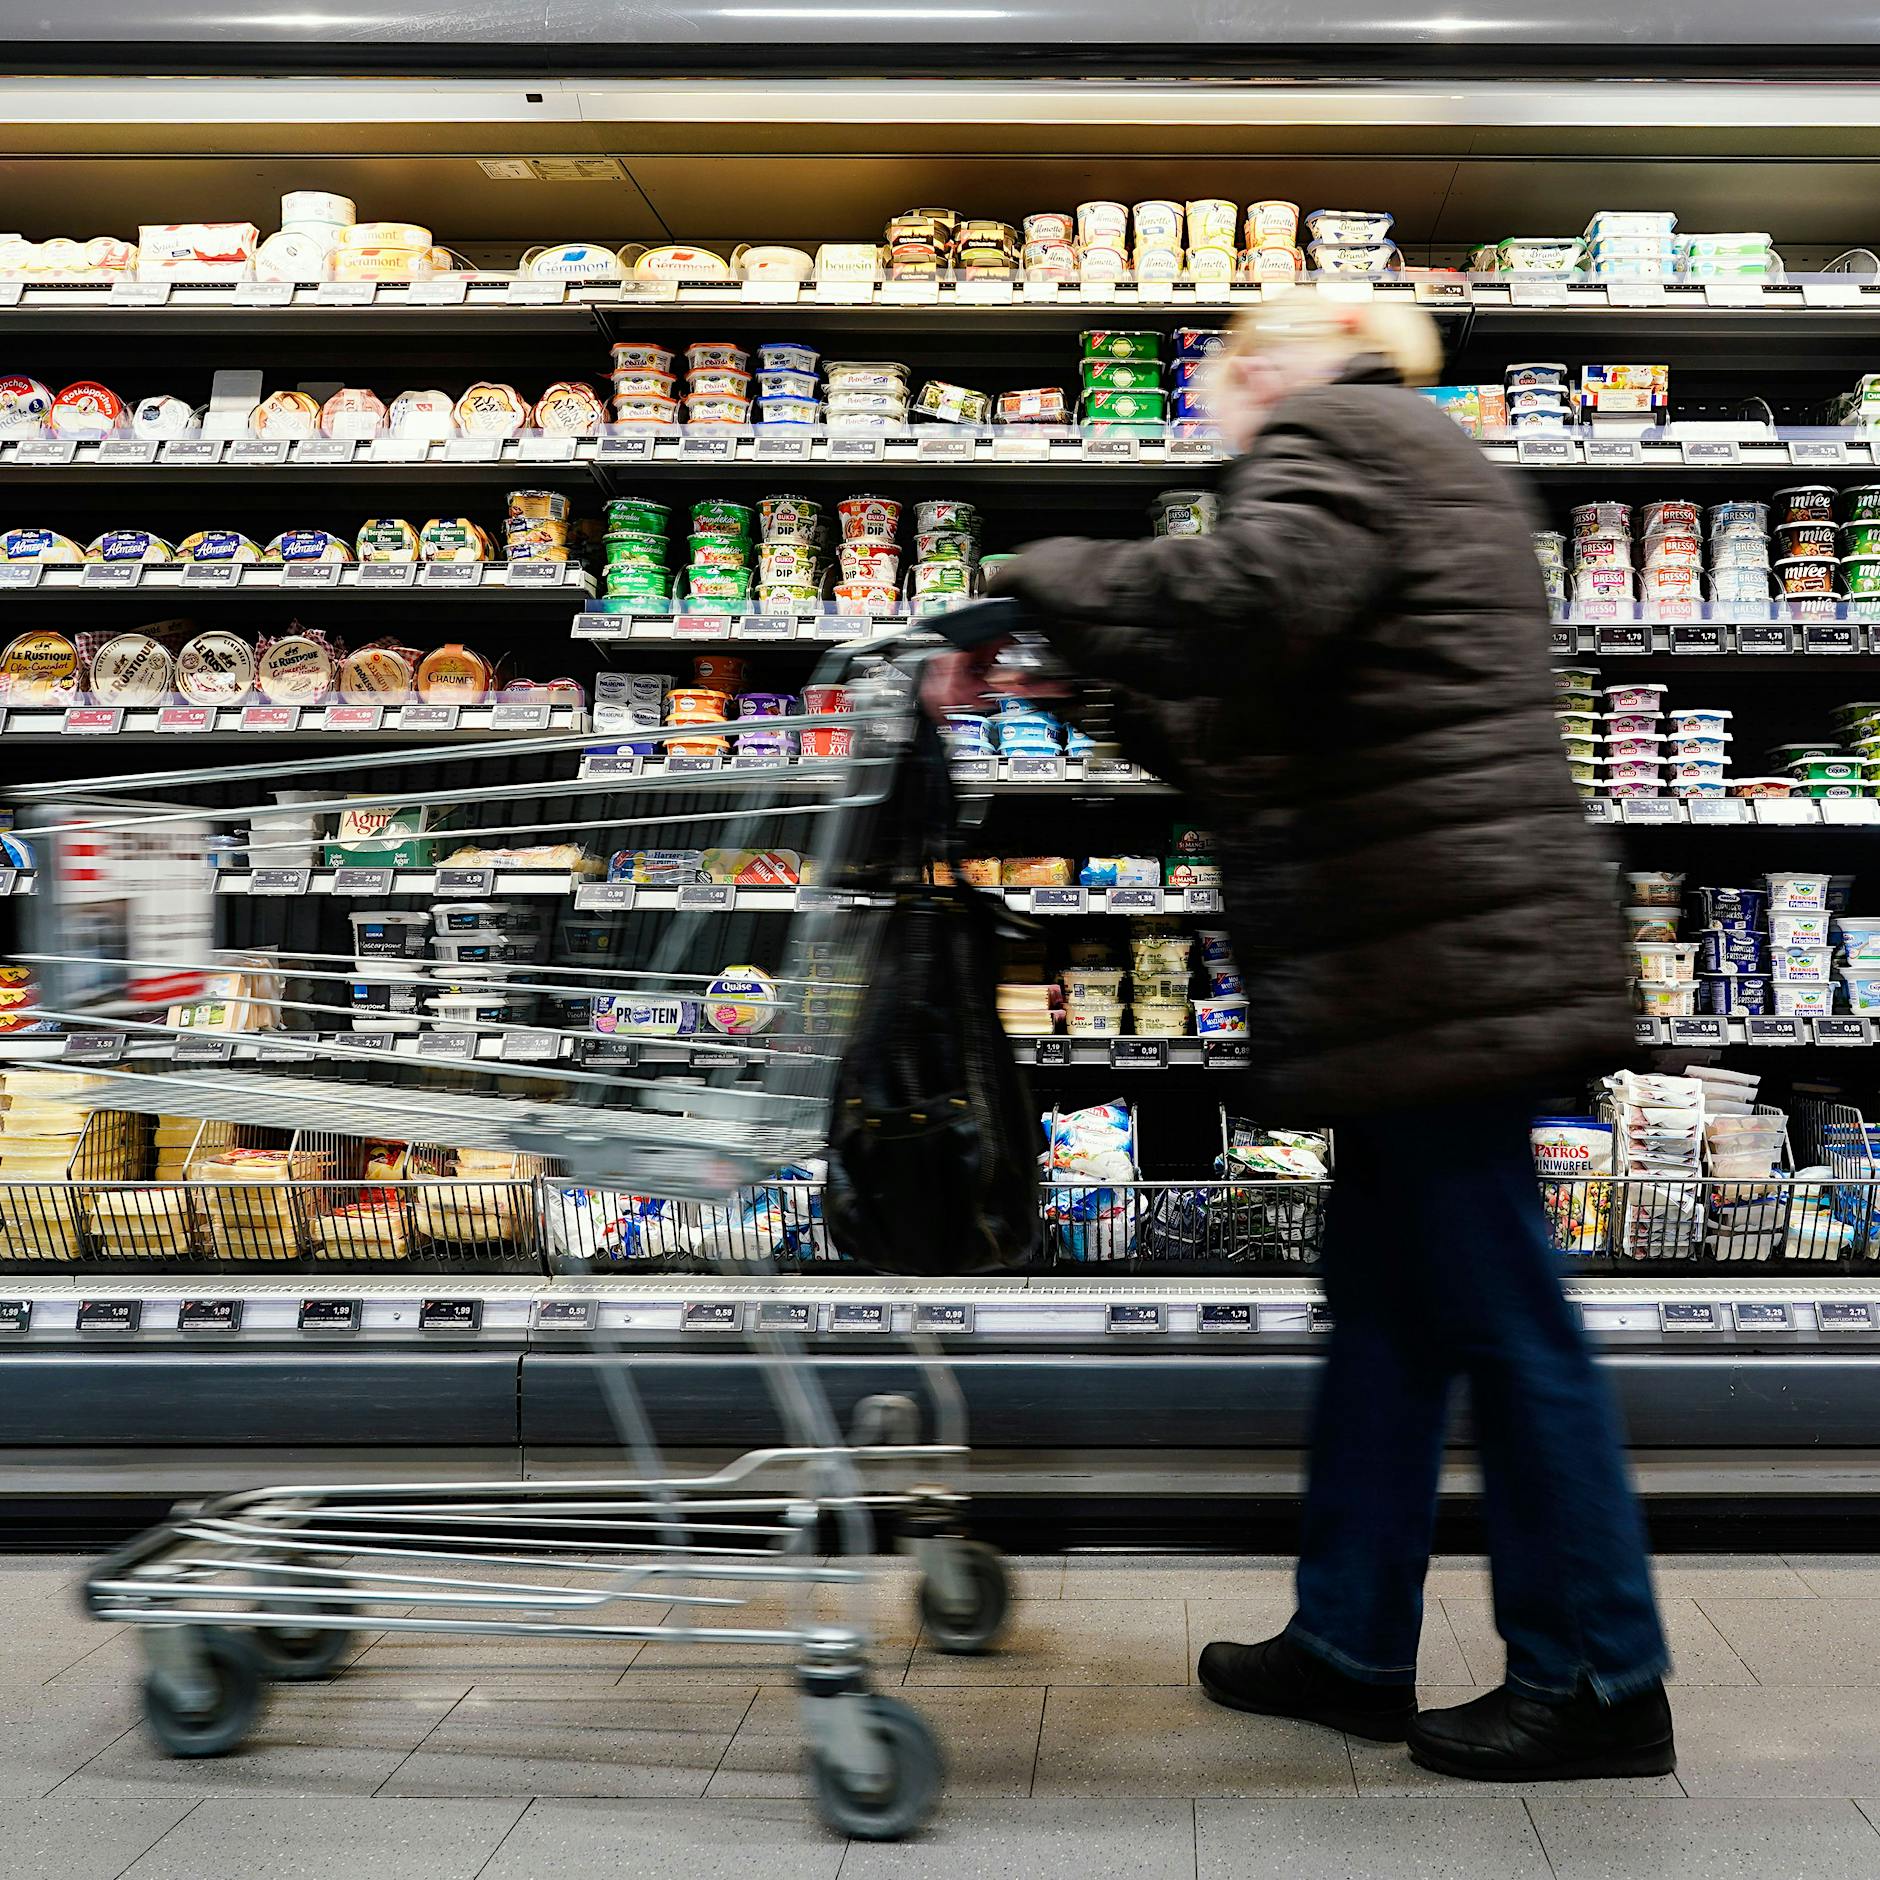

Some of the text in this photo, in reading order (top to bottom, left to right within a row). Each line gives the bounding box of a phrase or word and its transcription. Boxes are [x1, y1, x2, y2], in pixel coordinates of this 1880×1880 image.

[1338, 219, 1371, 232] Brunch
[1337, 248, 1370, 260] Brunch
[1529, 249, 1561, 260] Brunch
[825, 258, 873, 272] boursin
[62, 386, 113, 416] Rotkäppchen
[1790, 492, 1832, 509] miree
[777, 512, 796, 521] BUKO
[867, 511, 886, 520] BUKO
[1663, 510, 1694, 521] BRESSO
[1724, 510, 1755, 522] BRESSO
[777, 526, 794, 535] DIP
[867, 526, 884, 536] DIP
[1799, 524, 1836, 542] miree
[8, 540, 51, 556] Almzeit
[104, 540, 148, 557] Almzeit
[194, 540, 238, 557] Almzeit
[283, 540, 326, 557] Almzeit
[1582, 541, 1614, 554] BRESSO
[1665, 541, 1696, 553] BRESSO
[1735, 541, 1765, 553] BRESSO
[776, 555, 795, 564] BUKO
[776, 568, 793, 578] DIP
[845, 570, 857, 580] DIP
[1785, 563, 1828, 581] miree
[1593, 573, 1624, 586] BRESSO
[1659, 572, 1690, 584] BRESSO
[1739, 572, 1767, 584] BRESSO
[1586, 604, 1617, 616] BRESSO
[1800, 597, 1837, 614] miree
[1626, 632, 1642, 642] 1,79
[1700, 632, 1717, 641] 1,79
[1767, 632, 1784, 641] 1,79
[1834, 632, 1850, 642] 1,39
[193, 640, 208, 657] LE
[12, 650, 73, 664] LE RUSTIQUE
[269, 650, 320, 670] LE RUSTIQUE
[112, 640, 156, 693] RUSTIQUE
[427, 671, 474, 685] CHAUMES
[633, 681, 660, 690] PHILADELPHIA
[1620, 698, 1638, 706] BUKO
[1618, 724, 1635, 732] BUKO
[831, 736, 849, 744] PACK
[828, 744, 849, 756] XXL
[1621, 747, 1638, 755] BUKO
[1828, 766, 1848, 775] Exquisa
[344, 810, 391, 838] Agur
[653, 852, 683, 860] Harzer-
[328, 858, 345, 867] Agur
[393, 858, 410, 867] Agur
[752, 861, 774, 883] MINIS
[708, 890, 725, 899] 1,49
[1790, 894, 1818, 902] KERNIGER
[1790, 901, 1818, 909] Frischkäse
[1792, 930, 1820, 938] KERNIGER
[1793, 937, 1820, 945] Frischkäse
[721, 982, 753, 993] Quäse
[611, 1045, 628, 1053] 1,59
[1141, 1046, 1158, 1055] 0,99
[2, 1307, 19, 1317] 1,99
[111, 1307, 129, 1317] 1,99
[212, 1306, 230, 1316] 1,99
[332, 1306, 350, 1316] 1,99
[454, 1306, 471, 1316] 1,99
[568, 1306, 586, 1316] 0,59
[715, 1308, 733, 1317] 0,59
[790, 1308, 806, 1318] 2,19
[862, 1309, 880, 1318] 2,29
[945, 1309, 962, 1319] 0,99
[1138, 1310, 1156, 1319] 2,49
[1230, 1309, 1248, 1319] 1,79
[1692, 1308, 1710, 1318] 2,29
[1765, 1308, 1783, 1318] 2,29
[1848, 1308, 1867, 1317] 2,79
